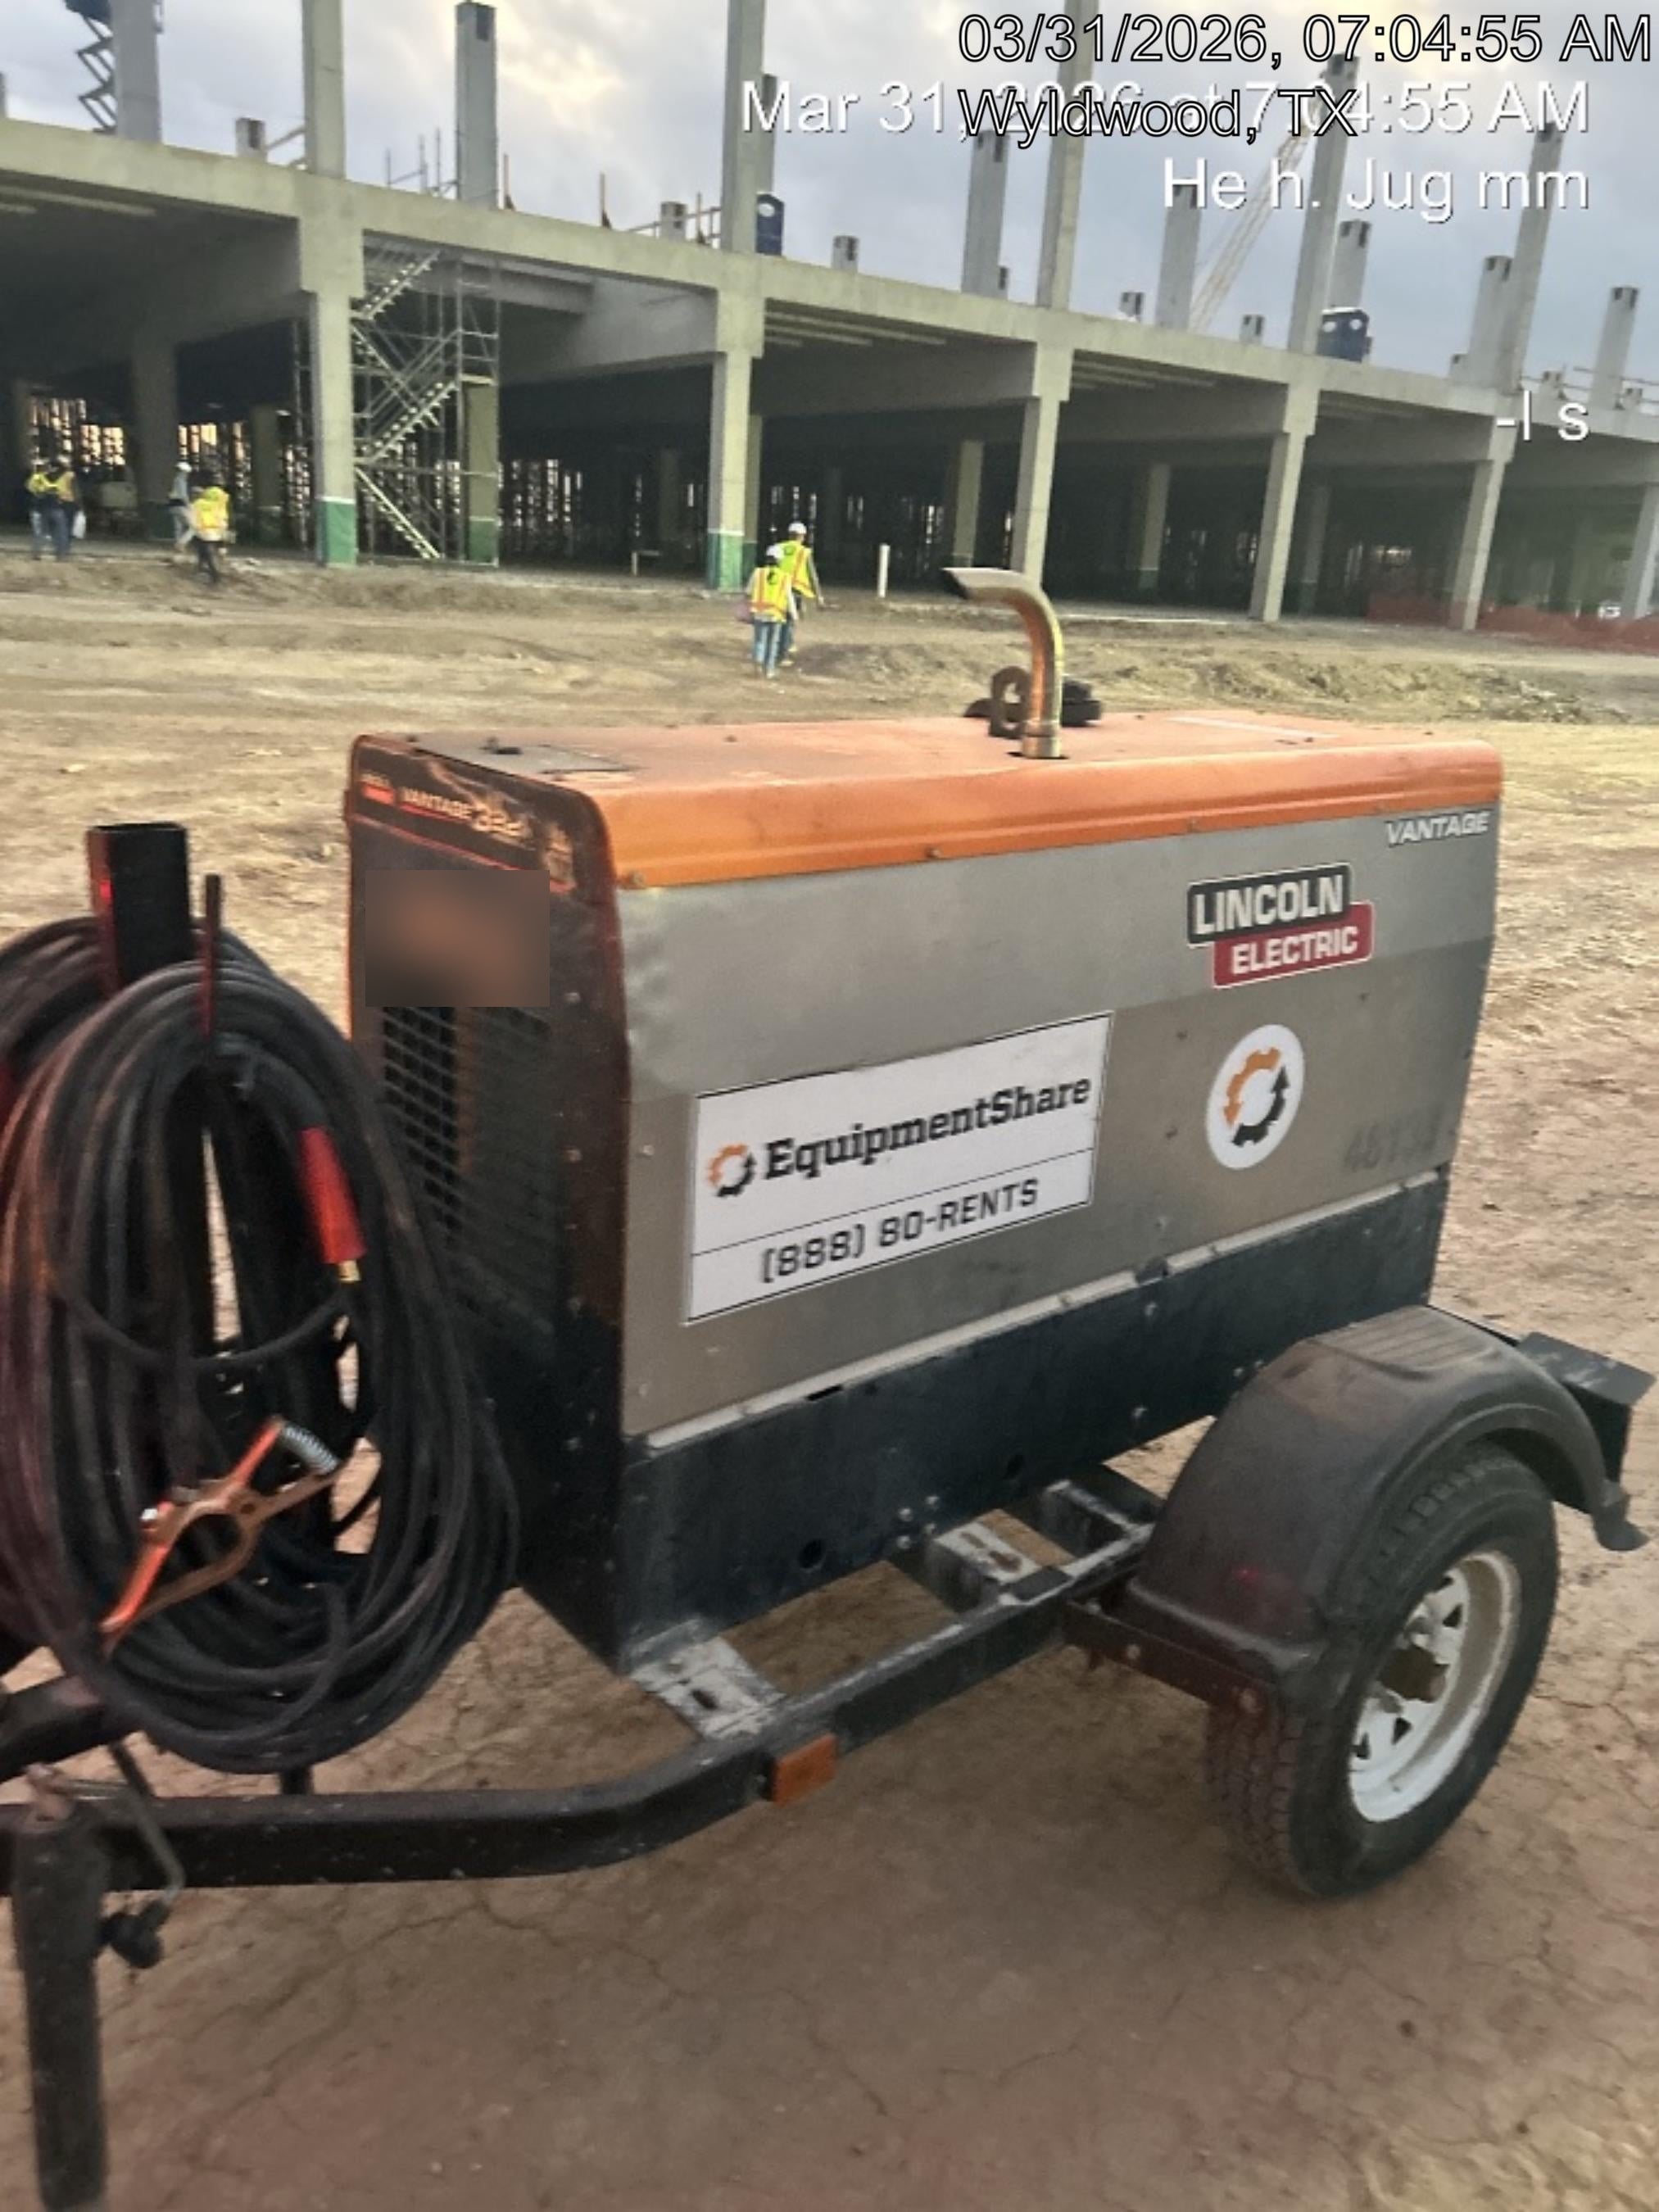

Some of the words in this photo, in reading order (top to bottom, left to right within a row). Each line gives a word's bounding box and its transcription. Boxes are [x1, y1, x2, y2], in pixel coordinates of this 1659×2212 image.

[1385, 810, 1492, 847] VANTAGE
[1193, 874, 1344, 936] LINCOLN
[1231, 926, 1359, 976] ELECTRIC
[764, 1077, 1091, 1180] EquipmentShare
[761, 1223, 866, 1284] (888)
[879, 1177, 1040, 1249] 80-RENTS
